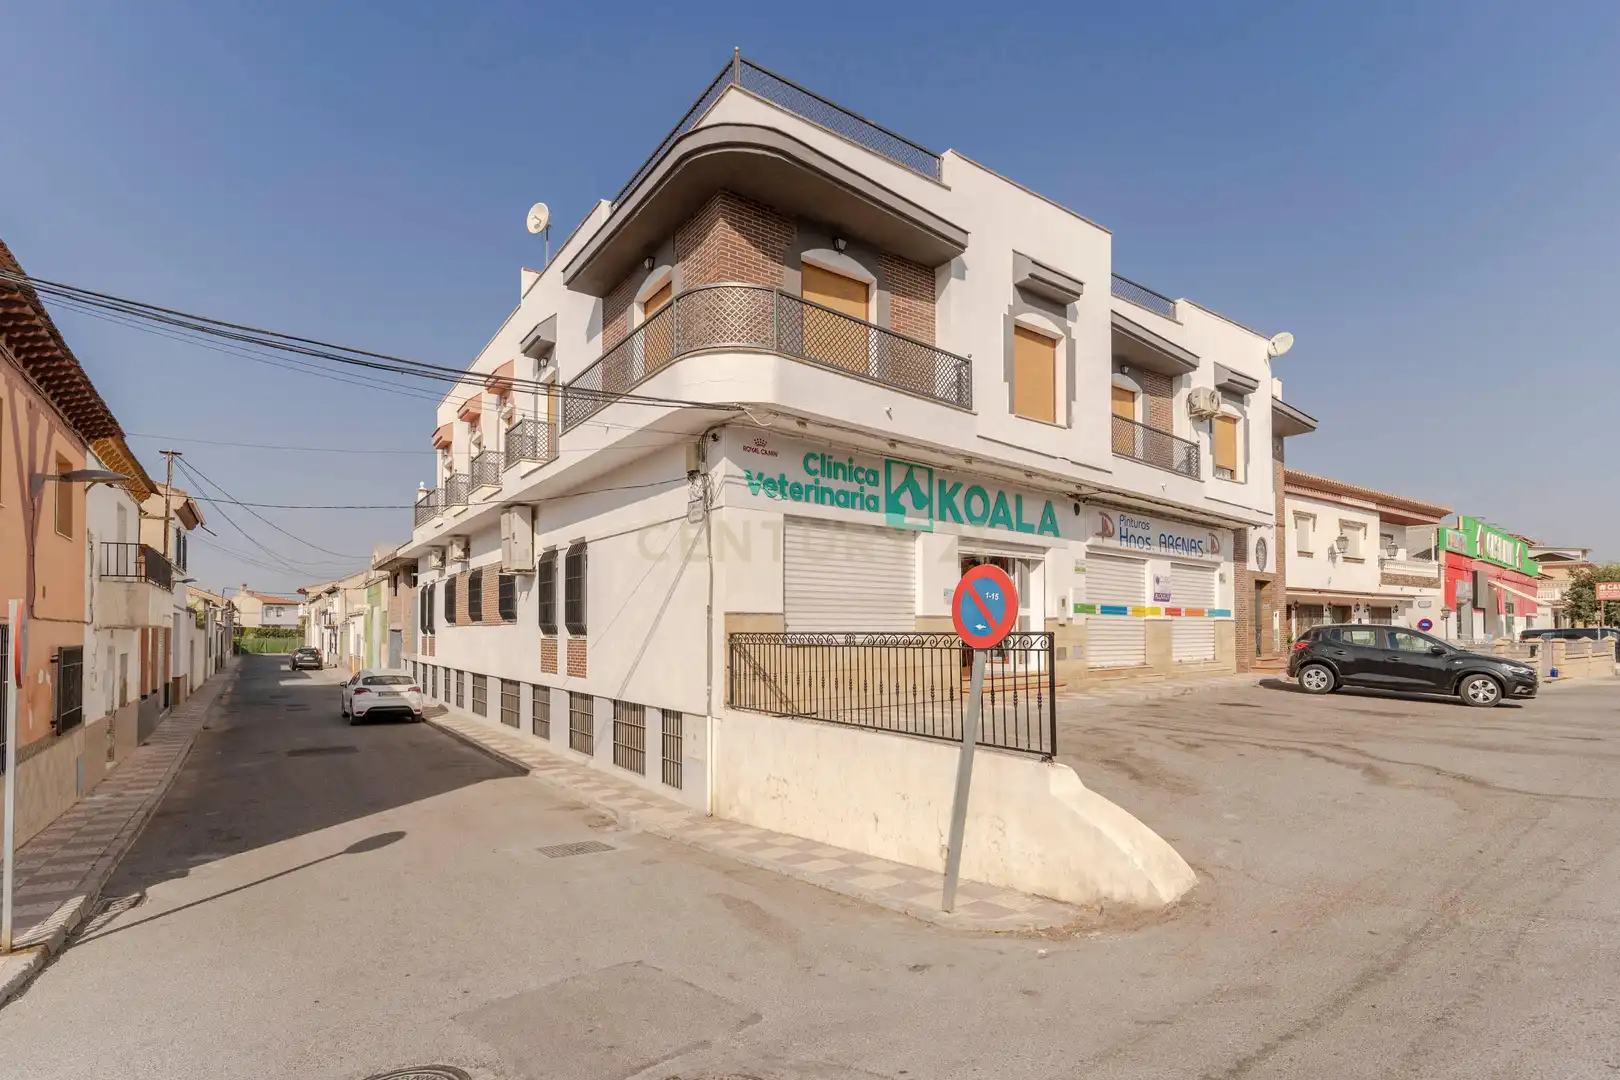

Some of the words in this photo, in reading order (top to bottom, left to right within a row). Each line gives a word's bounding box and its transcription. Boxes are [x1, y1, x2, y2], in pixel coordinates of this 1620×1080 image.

[742, 445, 760, 454] ROYAL
[760, 448, 779, 457] CANIN
[743, 469, 879, 508] Veterinaria
[938, 479, 1060, 537] KOALA
[1119, 514, 1150, 530] Pinturas
[1158, 533, 1204, 557] ARENAS
[985, 592, 999, 600] 1-15
